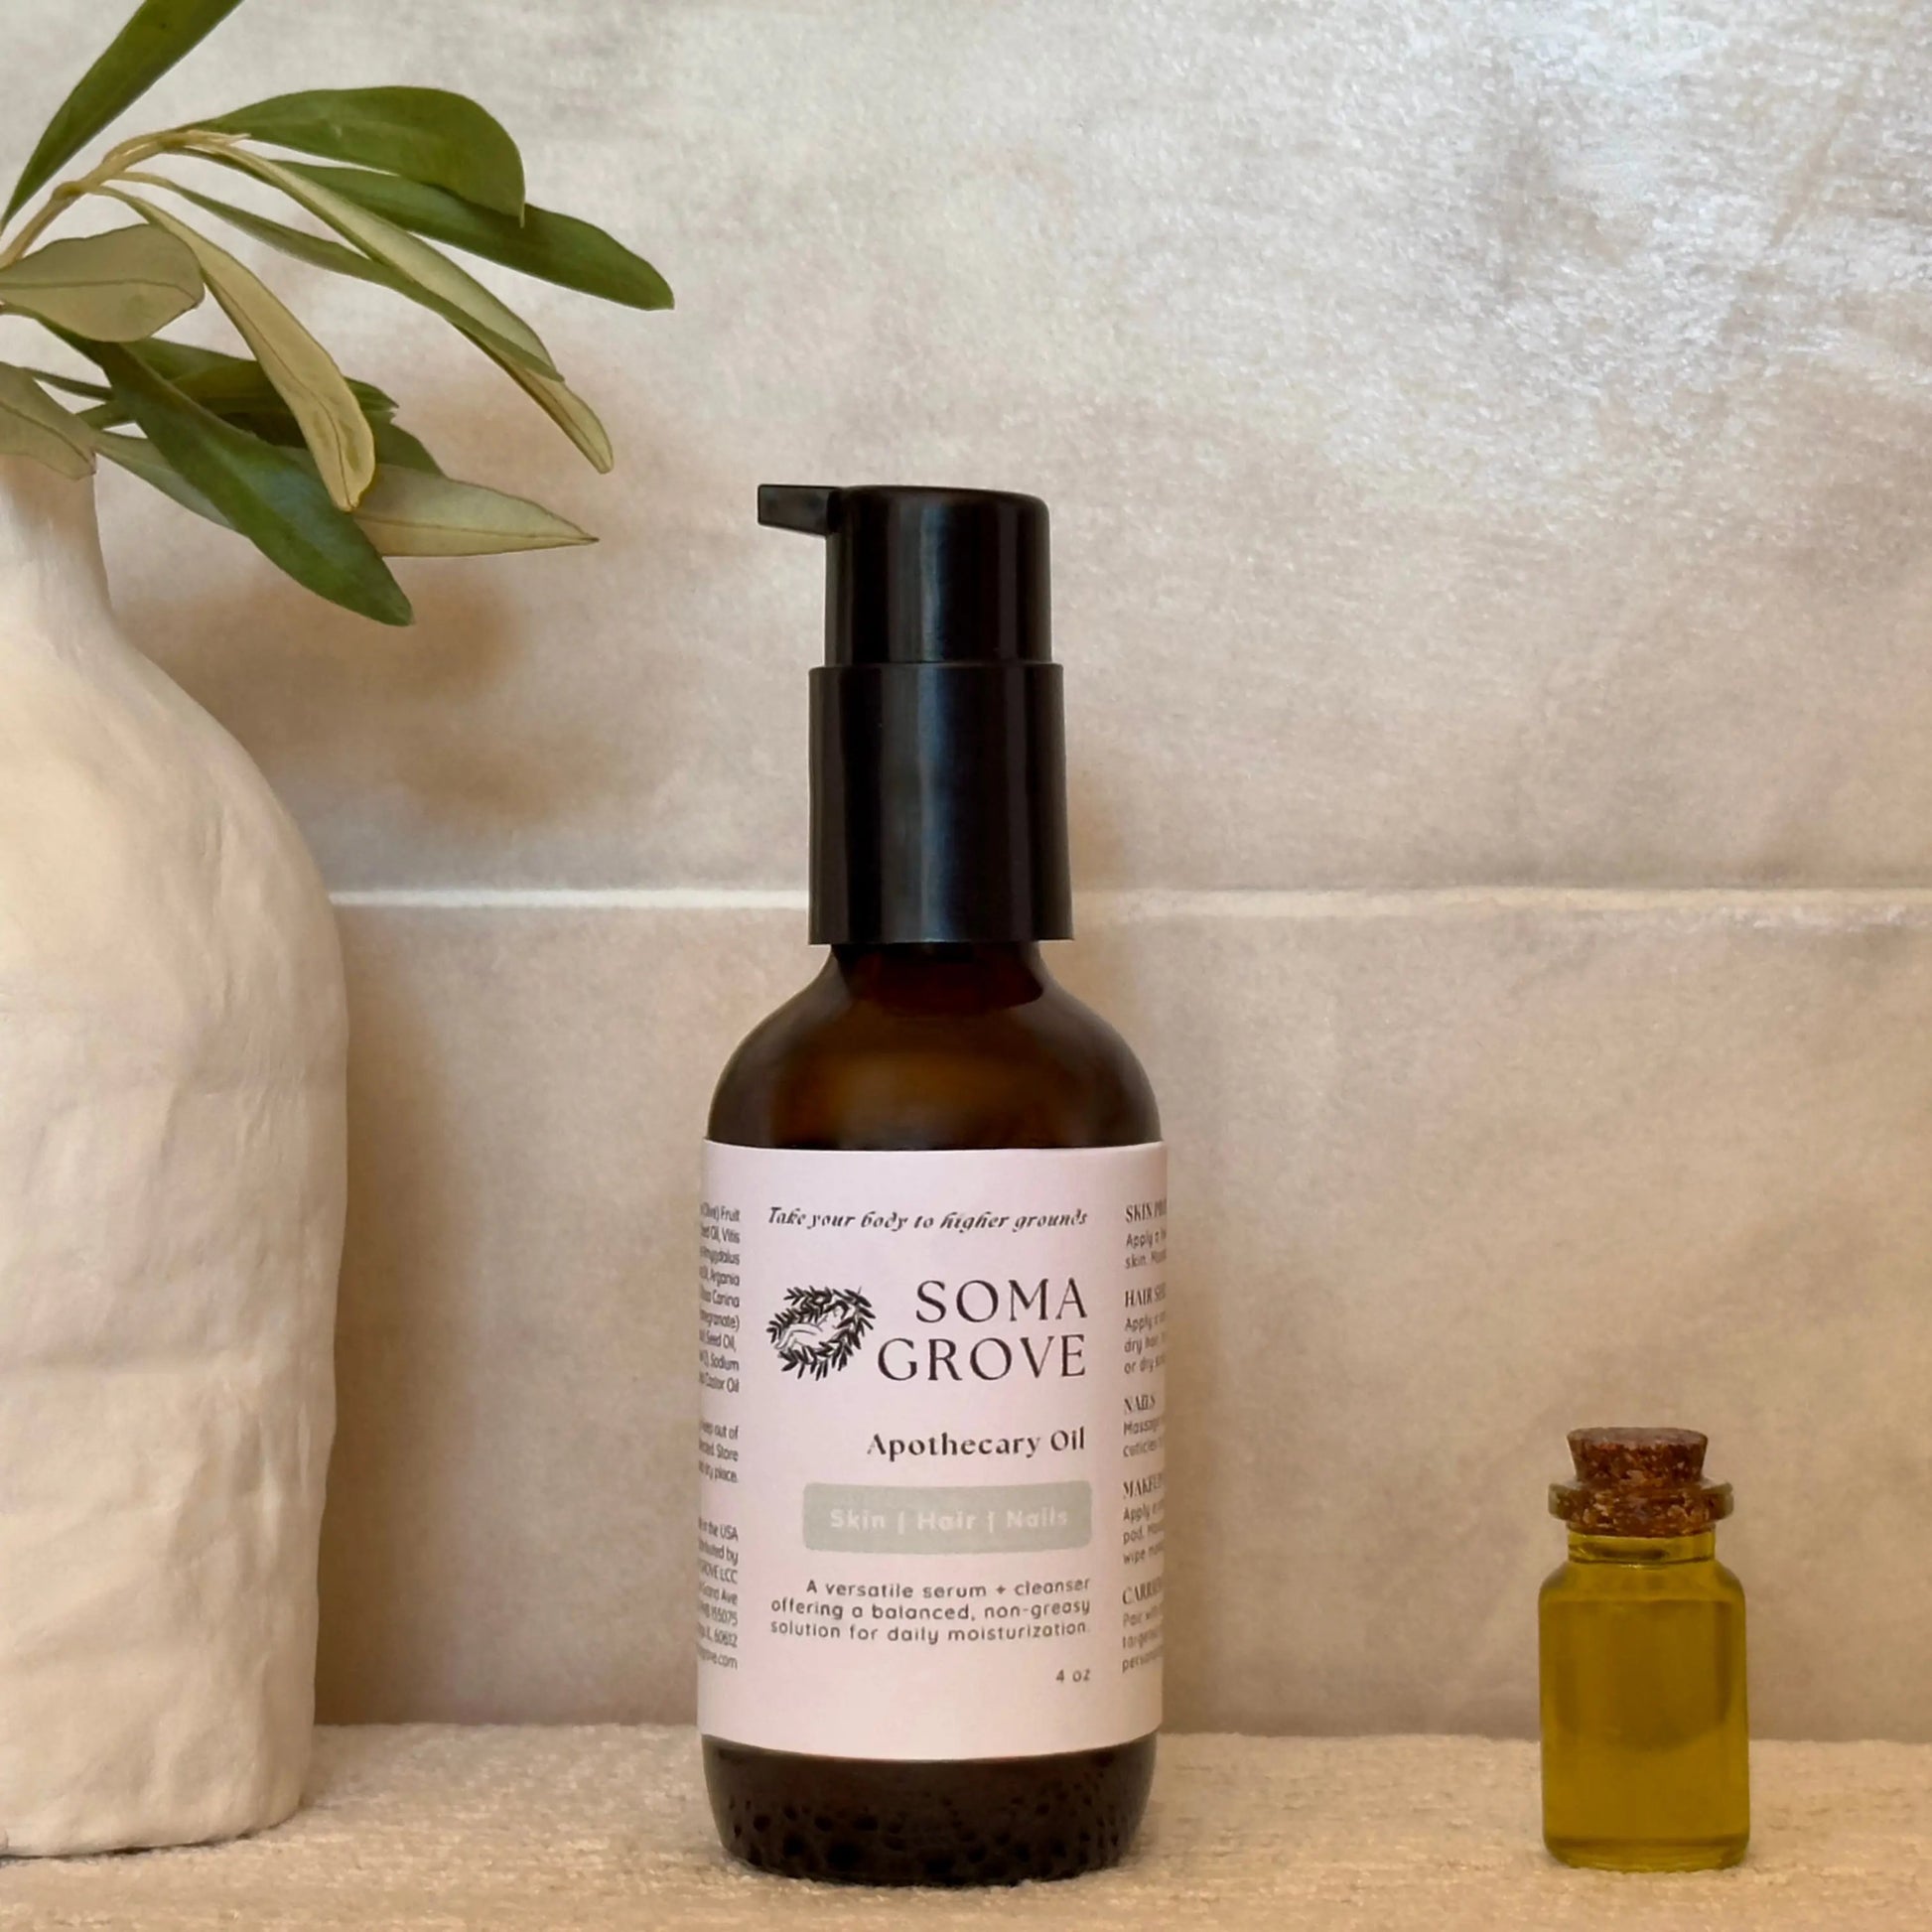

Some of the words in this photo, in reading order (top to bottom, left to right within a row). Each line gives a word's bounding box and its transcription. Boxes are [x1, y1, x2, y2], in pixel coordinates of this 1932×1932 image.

[768, 1206, 807, 1226] Take
[807, 1211, 856, 1231] your
[861, 1208, 908, 1232] body
[913, 1215, 934, 1229] to
[939, 1208, 1010, 1233] higher
[1013, 1209, 1088, 1233] grounds
[916, 1277, 1088, 1323] SOMA
[1124, 1287, 1153, 1308] HAIR
[878, 1333, 1086, 1382] GROVE
[867, 1430, 1040, 1462] Apothecary
[1050, 1426, 1084, 1451] Oil
[830, 1508, 886, 1530] Skin
[916, 1507, 977, 1532] Hair
[1007, 1506, 1068, 1530] Nails
[720, 1524, 739, 1542] USA
[806, 1579, 818, 1594] A
[825, 1579, 913, 1599] versatile
[922, 1584, 987, 1600] serum
[1013, 1578, 1091, 1597] cleanser
[770, 1596, 843, 1621] offering
[852, 1607, 864, 1620] a
[872, 1601, 977, 1622] balanced,
[984, 1598, 1091, 1620] non-greasy
[770, 1617, 842, 1639] solution
[849, 1619, 879, 1640] for
[888, 1621, 939, 1646] daily
[1055, 1669, 1065, 1684] 4
[1072, 1668, 1090, 1683] oz
